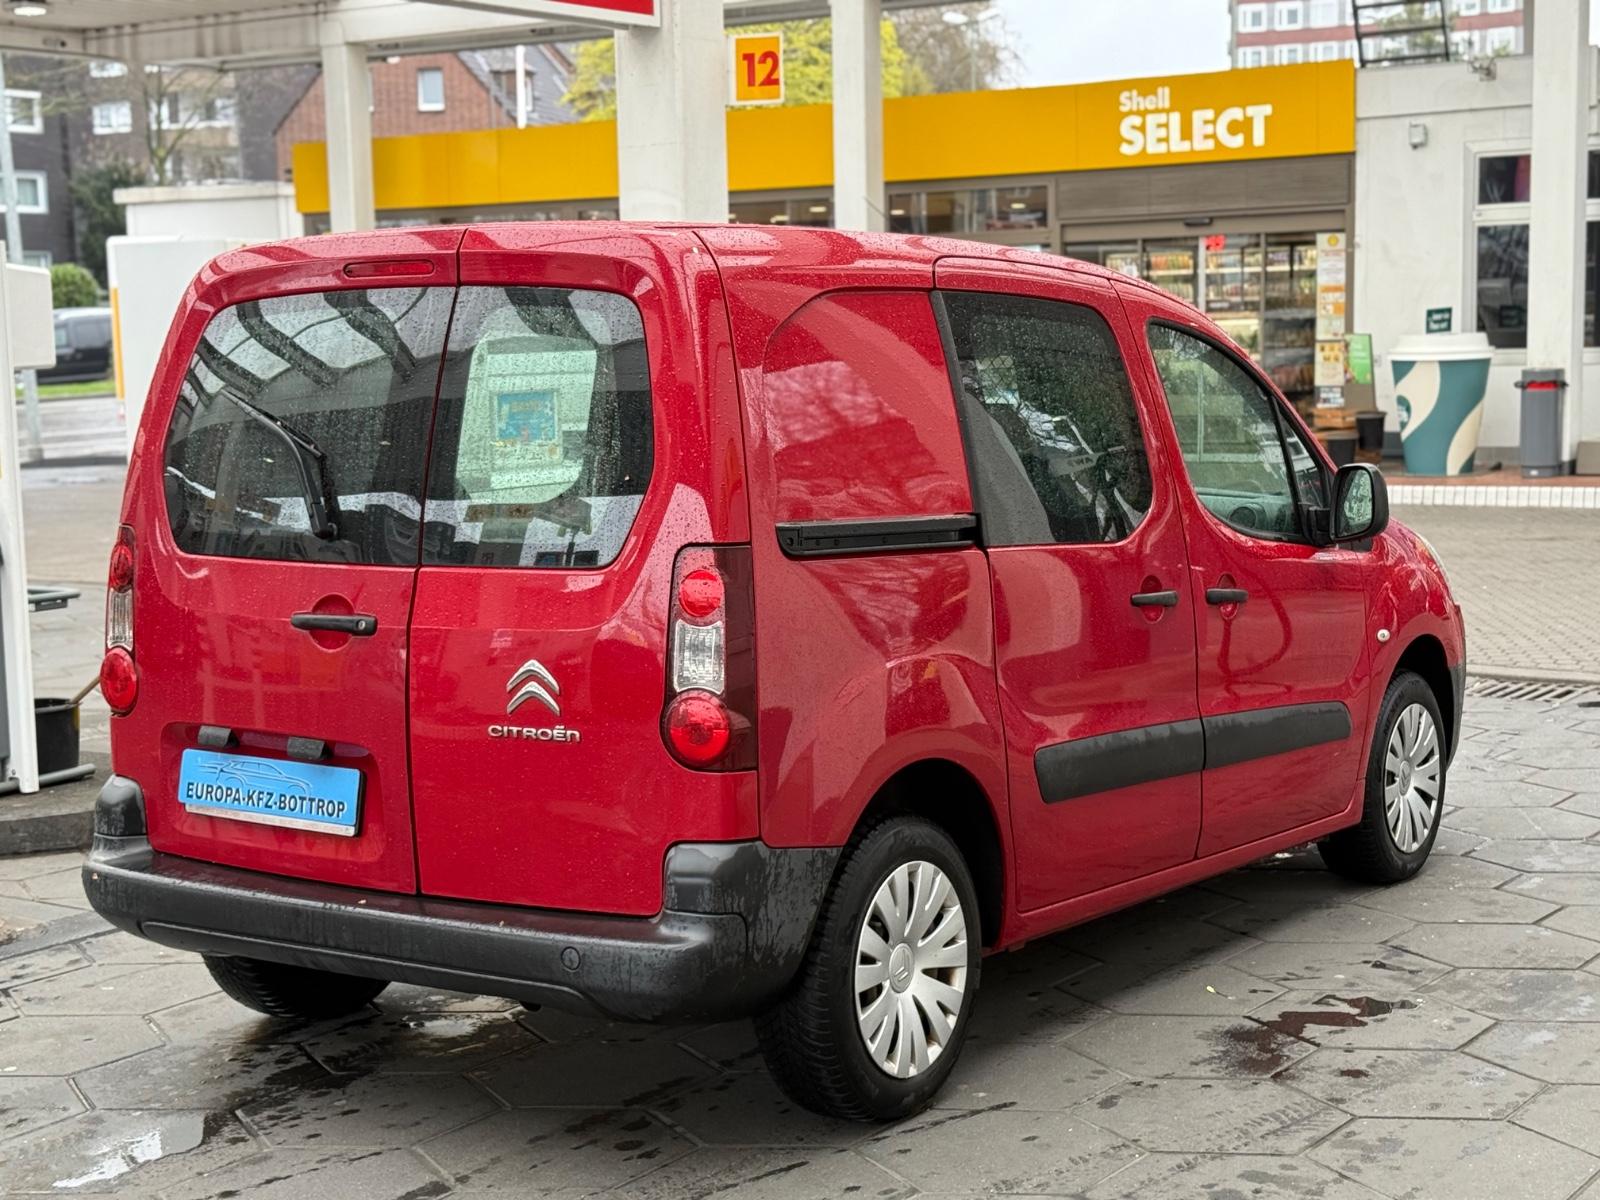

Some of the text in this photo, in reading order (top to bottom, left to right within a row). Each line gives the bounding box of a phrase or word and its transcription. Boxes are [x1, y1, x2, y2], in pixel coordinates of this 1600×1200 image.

[742, 50, 780, 87] 12
[1119, 86, 1170, 112] Shell
[1119, 104, 1273, 156] SELECT
[186, 782, 346, 818] EUROPA-KFZ-BOTTROP
